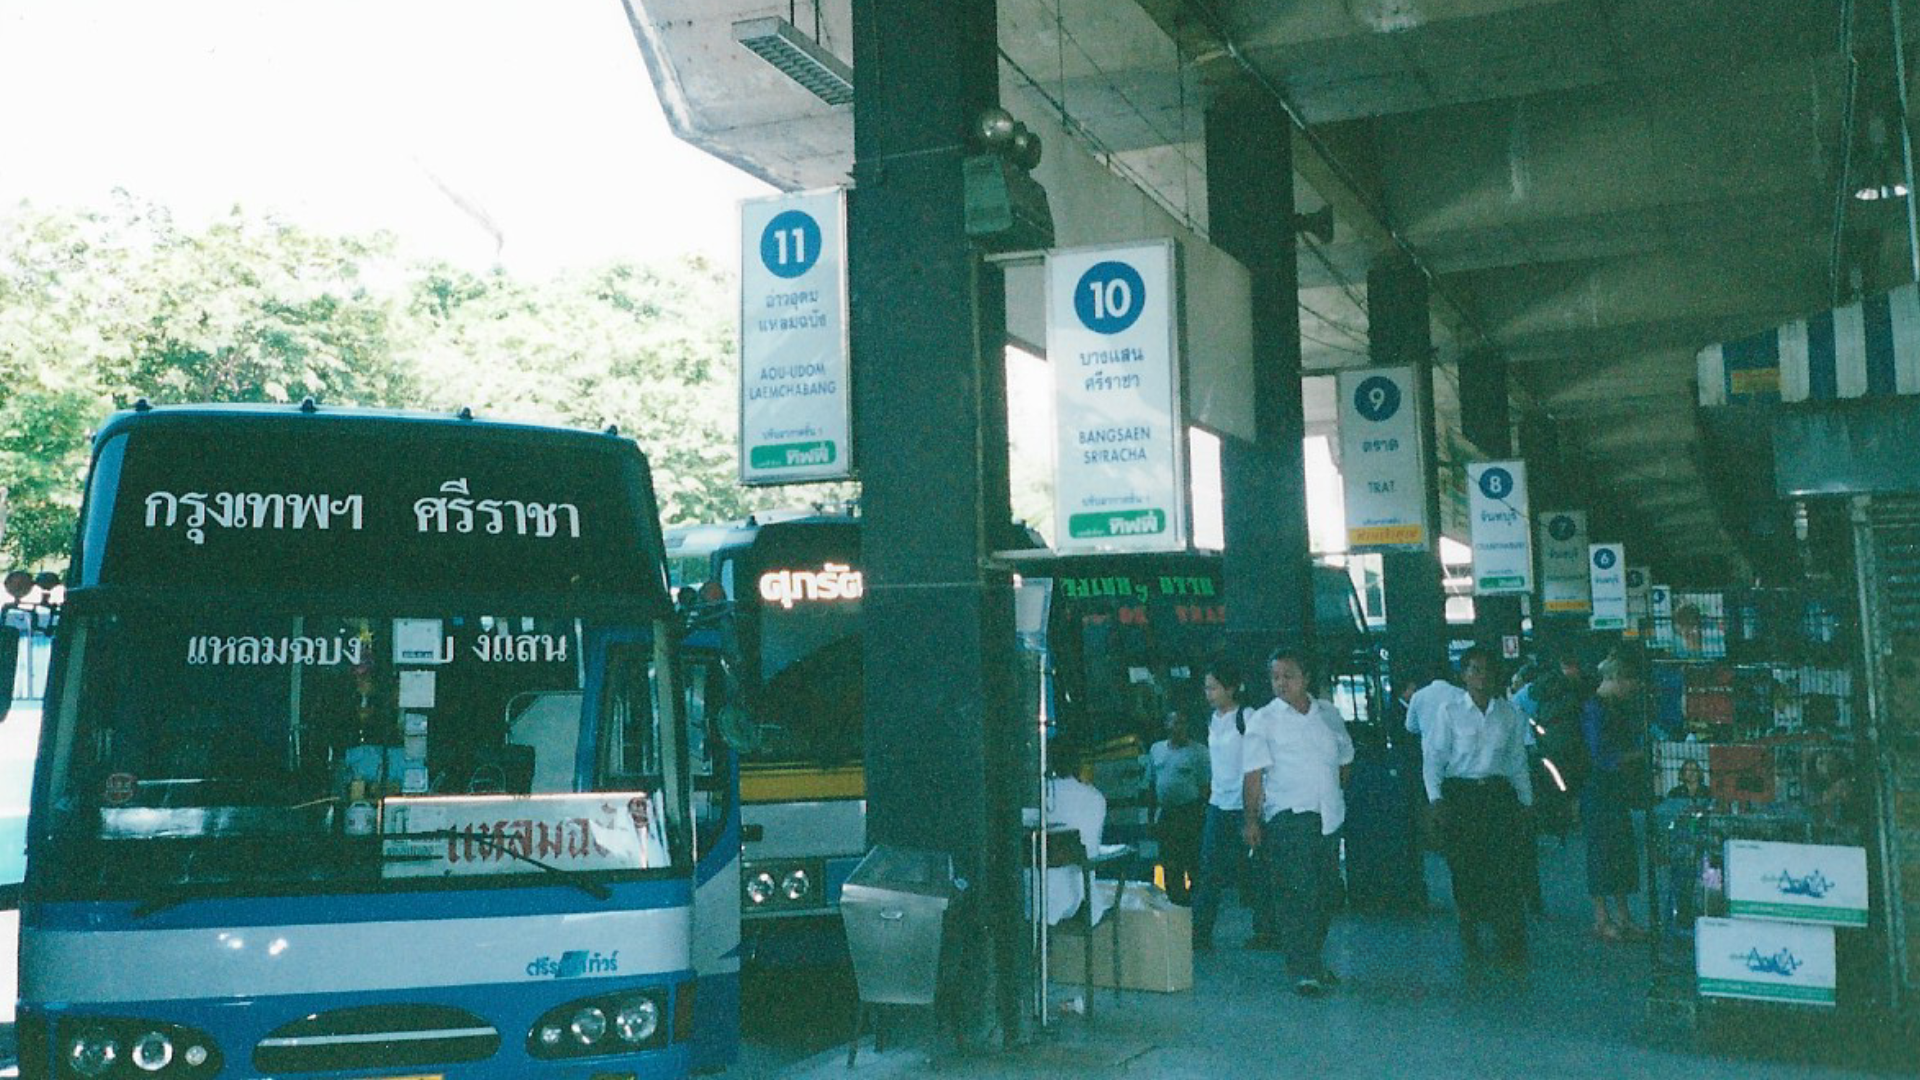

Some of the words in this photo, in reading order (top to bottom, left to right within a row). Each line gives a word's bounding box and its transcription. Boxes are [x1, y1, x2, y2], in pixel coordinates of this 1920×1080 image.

[774, 227, 806, 265] 11
[1090, 277, 1132, 319] 10
[1079, 347, 1145, 366] บางแสน
[760, 362, 826, 380] AOU-UDOM
[1084, 370, 1140, 391] ศรีราชา
[749, 381, 837, 400] LAEMCHABANG
[1368, 387, 1385, 411] 9
[1079, 425, 1152, 445] BANGSAEN
[1083, 446, 1148, 465] SRIRACHA
[1367, 480, 1396, 494] TRAT
[1489, 475, 1503, 494] 8
[144, 487, 364, 545] กรุงเทพฯ
[413, 478, 581, 538] ศรีราชา
[1600, 552, 1610, 565] 6
